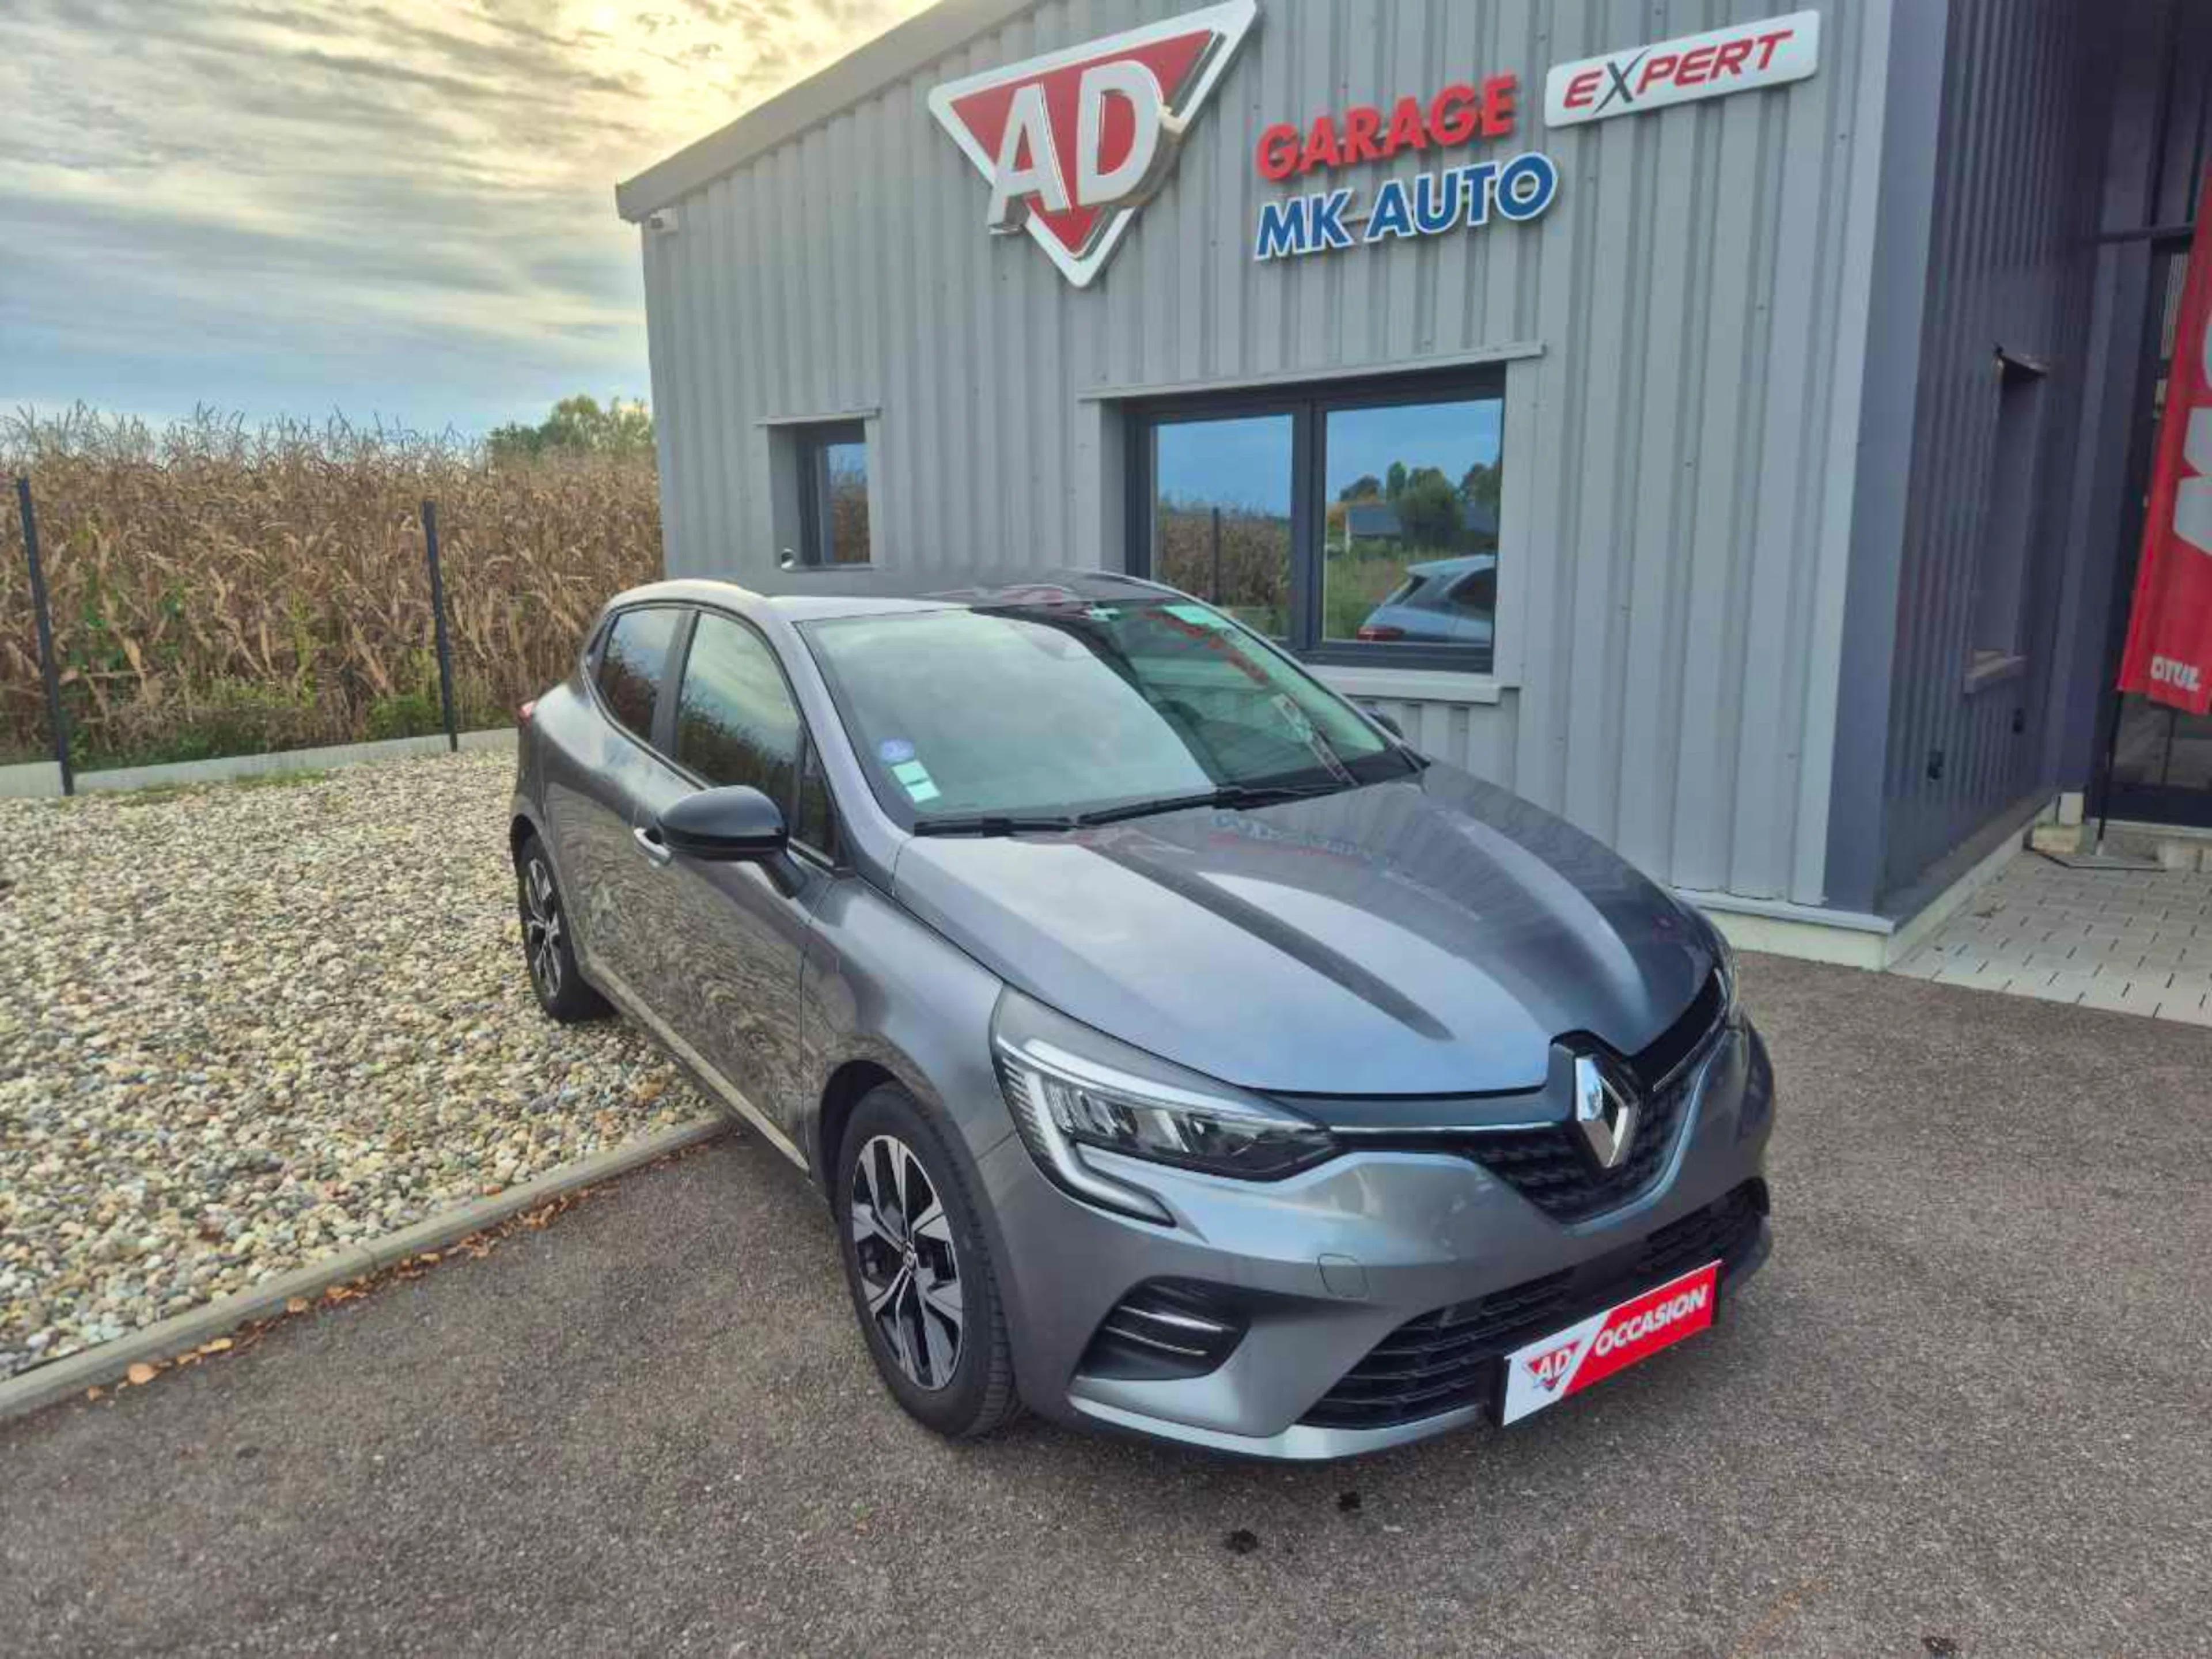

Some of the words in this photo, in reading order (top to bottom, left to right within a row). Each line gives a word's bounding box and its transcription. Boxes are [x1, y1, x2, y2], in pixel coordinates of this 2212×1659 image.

[1562, 29, 1794, 115] EXPERT
[988, 60, 1164, 234] AD
[1255, 73, 1517, 180] GARAGE
[1253, 187, 1355, 260] MK
[1363, 151, 1558, 243] AUTO
[1533, 1348, 1574, 1388] AD
[1594, 1283, 1710, 1357] OCCASION
